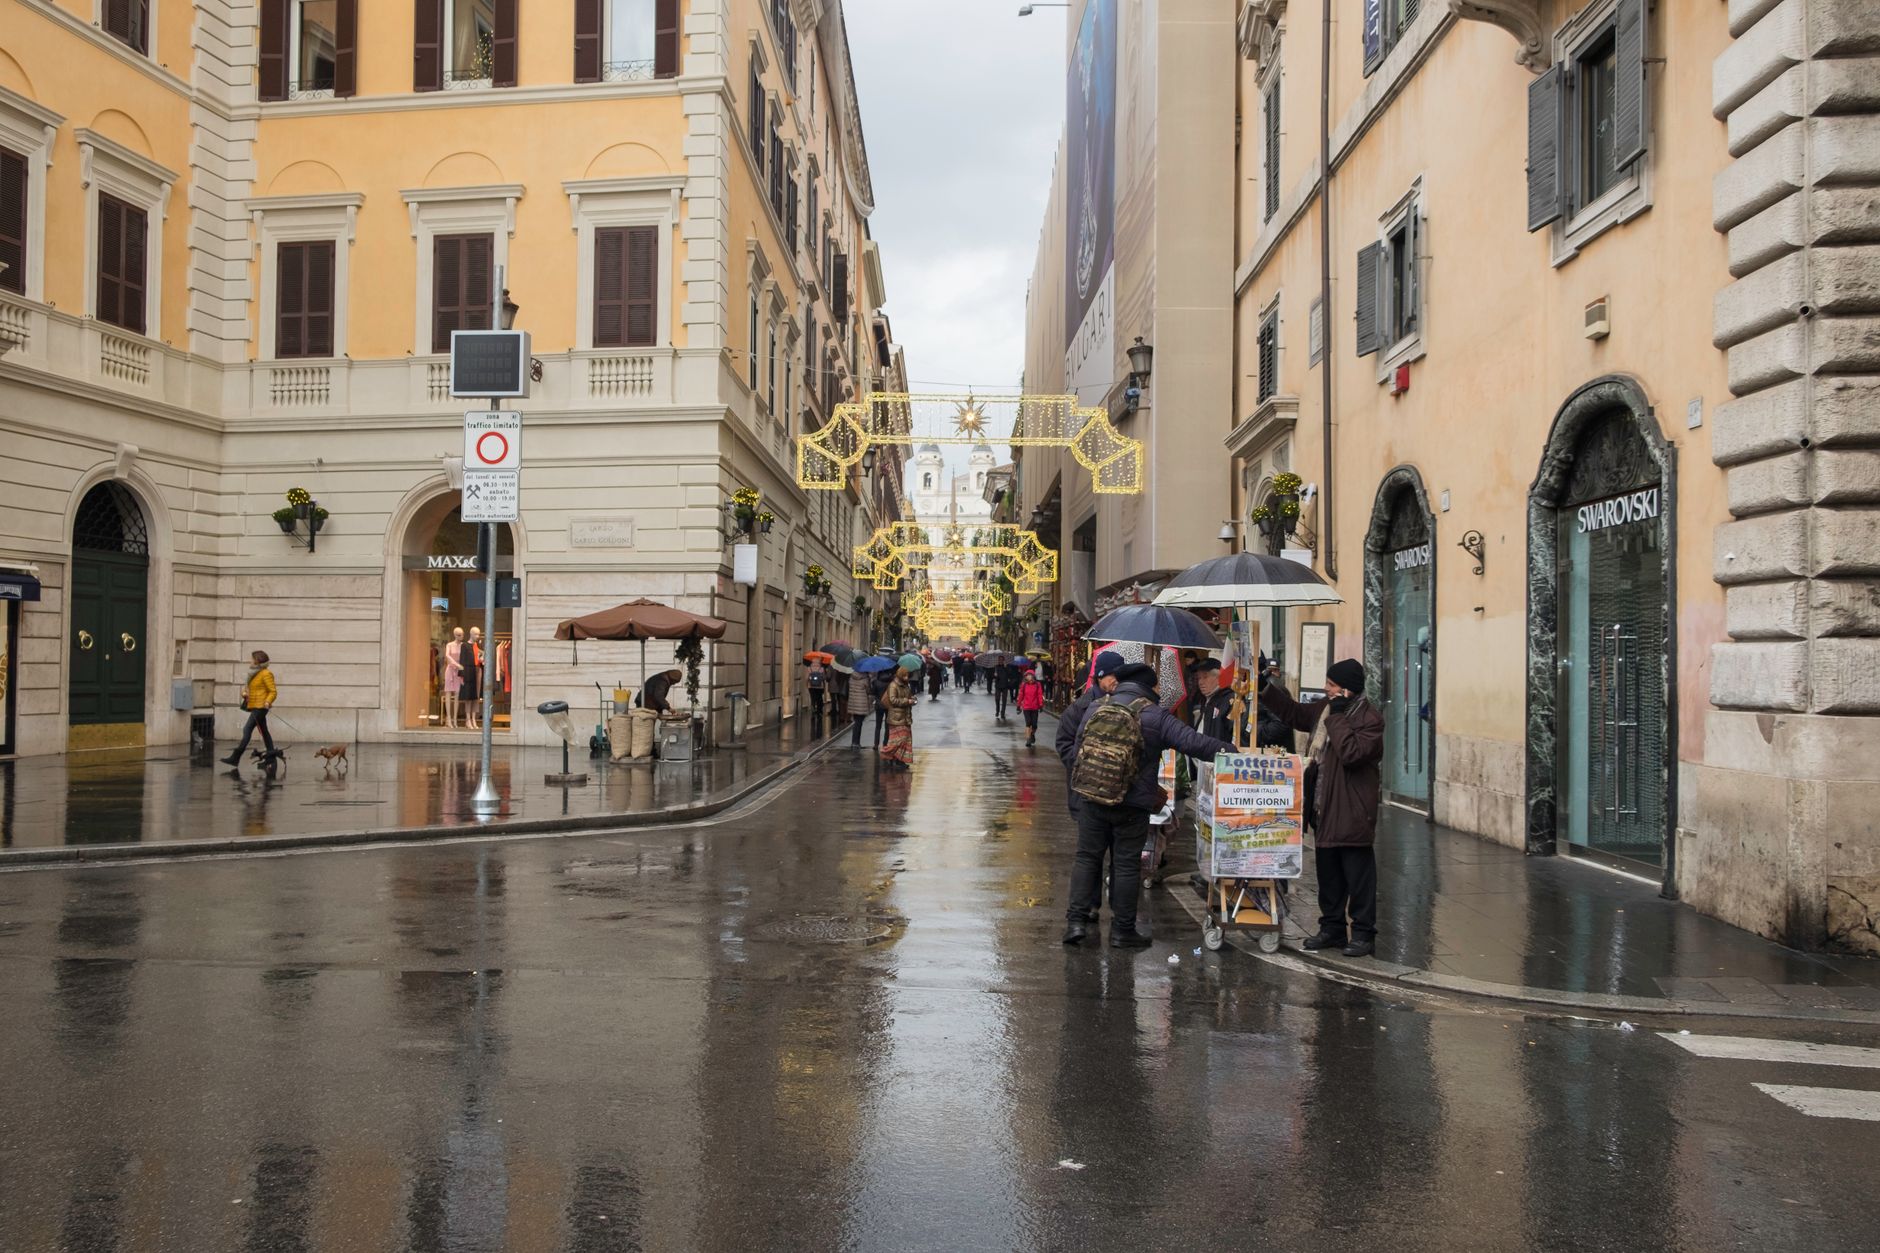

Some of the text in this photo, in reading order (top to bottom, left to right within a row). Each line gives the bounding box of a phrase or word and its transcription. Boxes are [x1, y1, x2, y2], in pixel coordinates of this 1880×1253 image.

[467, 421, 519, 429] traffico limitato
[1577, 488, 1658, 533] SWAROVSKI
[1225, 757, 1293, 769] Lotteria
[1233, 768, 1286, 783] Italia
[1223, 797, 1289, 806] ULTIMI GIORNI
